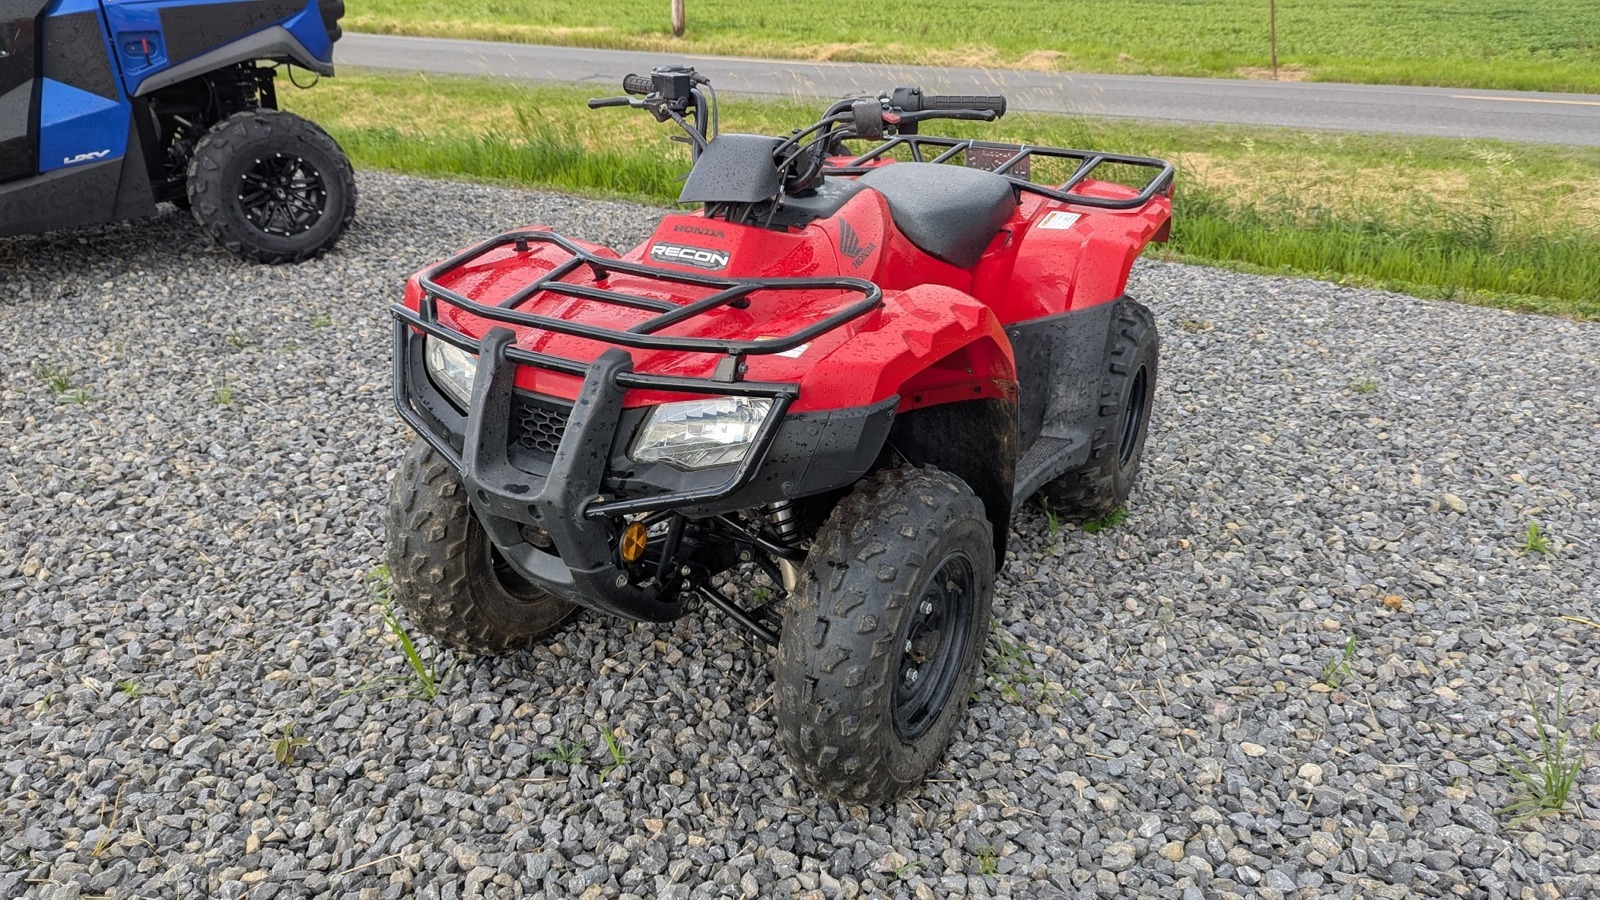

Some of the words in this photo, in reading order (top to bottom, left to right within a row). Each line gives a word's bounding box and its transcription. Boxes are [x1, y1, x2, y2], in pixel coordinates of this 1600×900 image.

[673, 224, 726, 239] HONDA
[651, 245, 729, 267] RECON
[852, 243, 876, 269] HONDA
